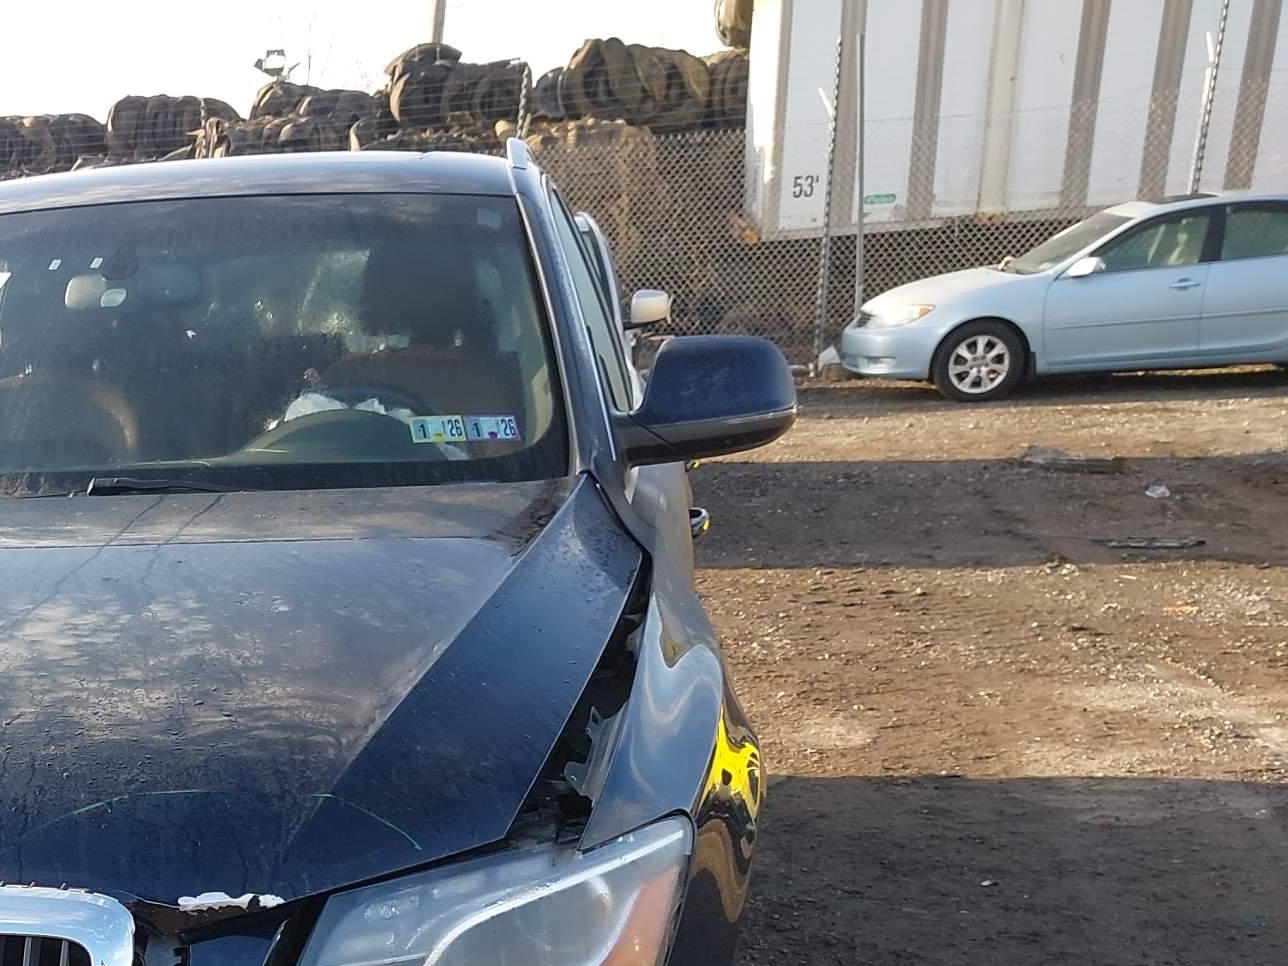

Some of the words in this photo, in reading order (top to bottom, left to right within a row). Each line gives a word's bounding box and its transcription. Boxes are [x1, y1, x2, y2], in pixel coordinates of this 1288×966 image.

[792, 175, 820, 199] 53'
[447, 418, 463, 438] 26
[500, 418, 517, 437] 26
